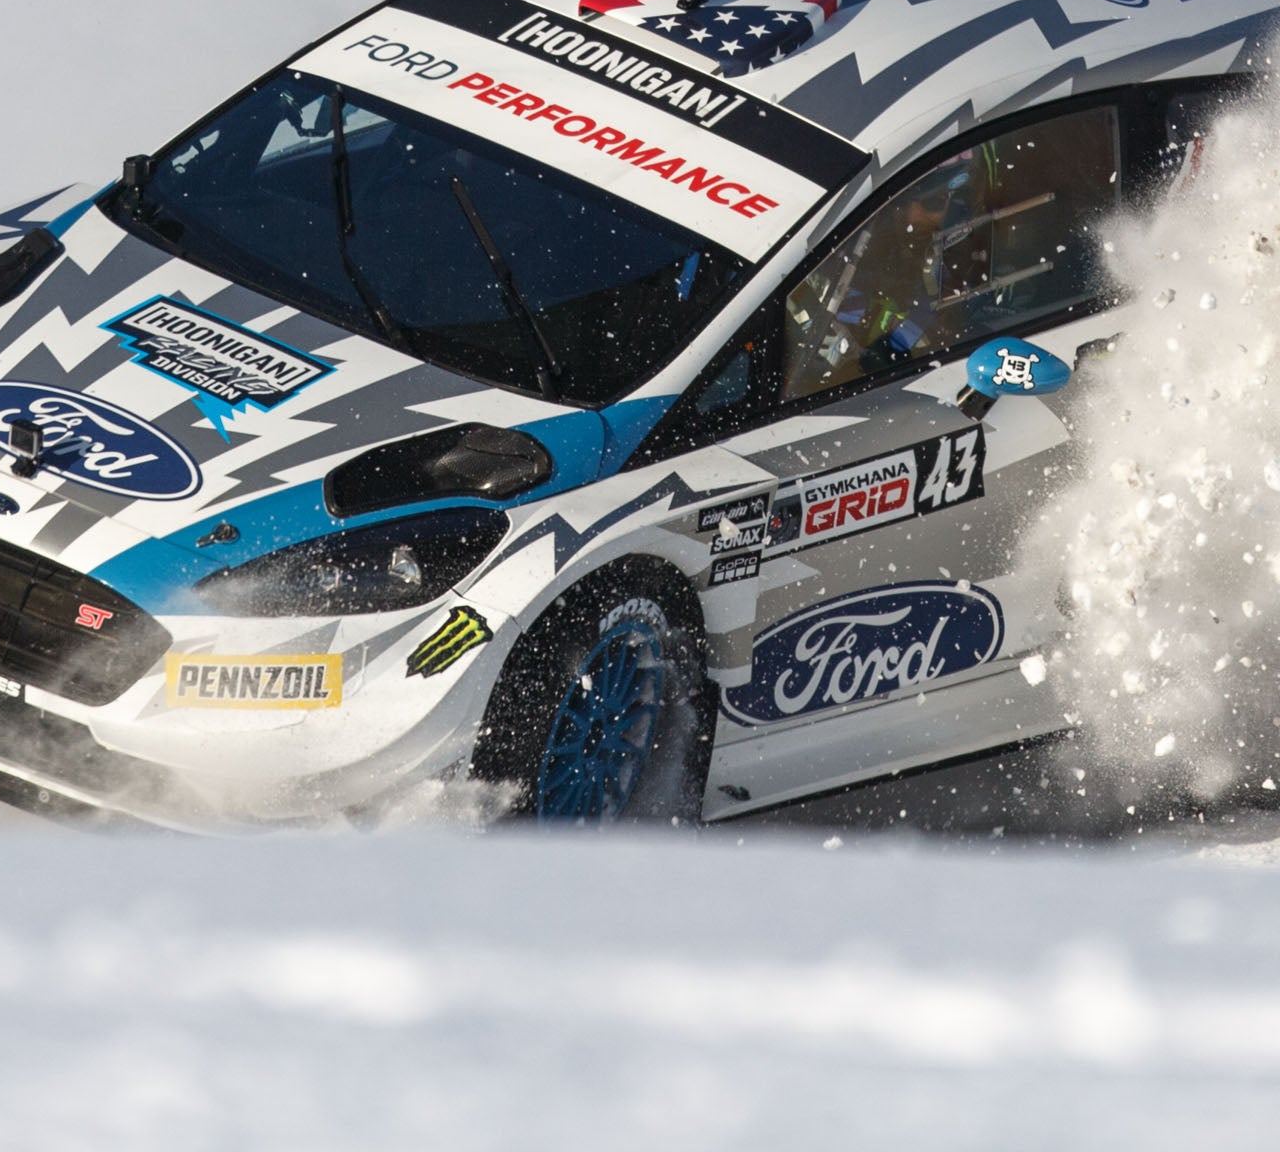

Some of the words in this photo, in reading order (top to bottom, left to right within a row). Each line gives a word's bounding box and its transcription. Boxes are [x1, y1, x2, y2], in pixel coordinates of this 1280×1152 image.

[497, 13, 746, 128] [HOONIGAN]
[343, 35, 459, 81] FORD
[447, 72, 779, 219] PERFORMANCE
[133, 306, 311, 386] [HOONIGAN]
[139, 336, 279, 395] RACING
[1007, 359, 1026, 372] 43
[150, 356, 241, 400] DIVISION
[805, 462, 910, 504] GYMKHANA
[919, 430, 979, 508] 43
[714, 528, 761, 552] SONAX
[715, 556, 758, 572] GoPro
[75, 604, 113, 630] ST
[177, 664, 330, 699] PENNZOIL
[774, 605, 950, 715] Ford
